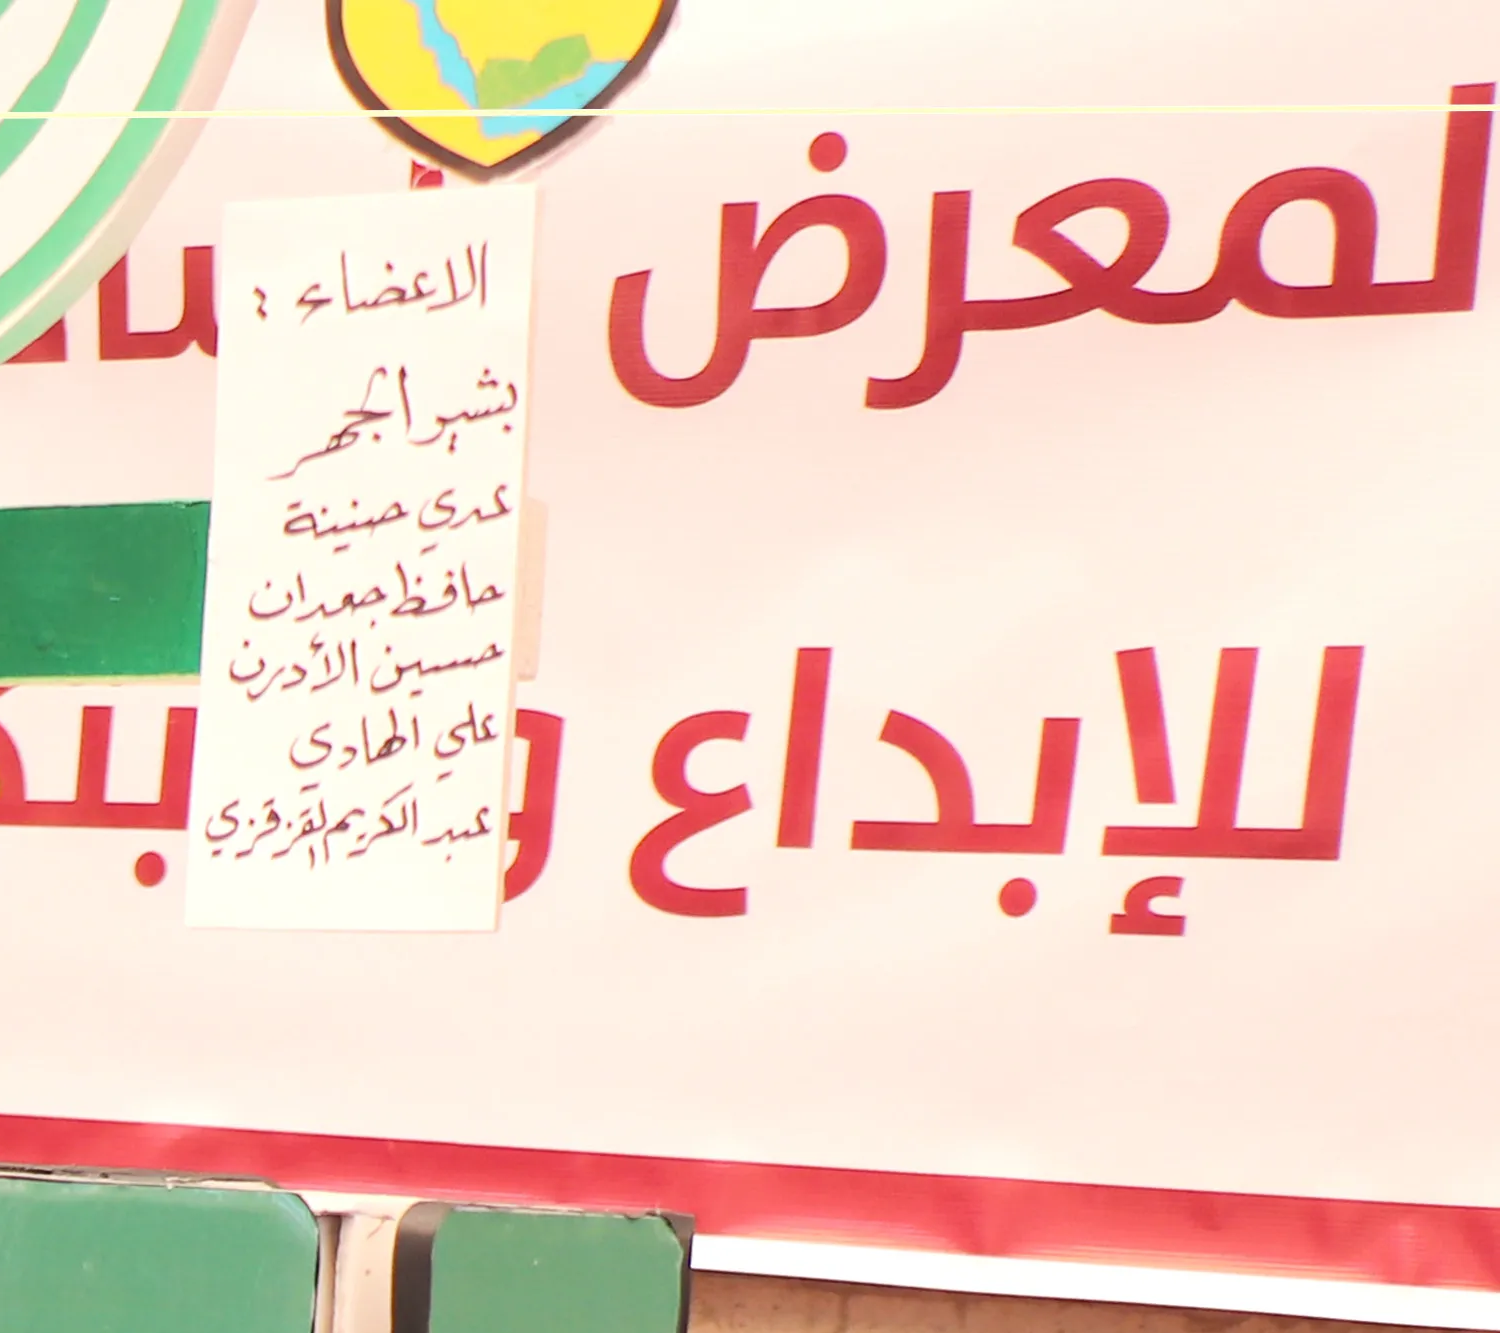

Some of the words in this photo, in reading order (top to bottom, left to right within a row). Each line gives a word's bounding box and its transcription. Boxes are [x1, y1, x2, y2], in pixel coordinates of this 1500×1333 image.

[390, 560, 505, 618] حافظ
[370, 641, 505, 698] حسين
[433, 701, 498, 782] علي
[628, 645, 1364, 937] للإبداع
[421, 805, 492, 862] عبد
